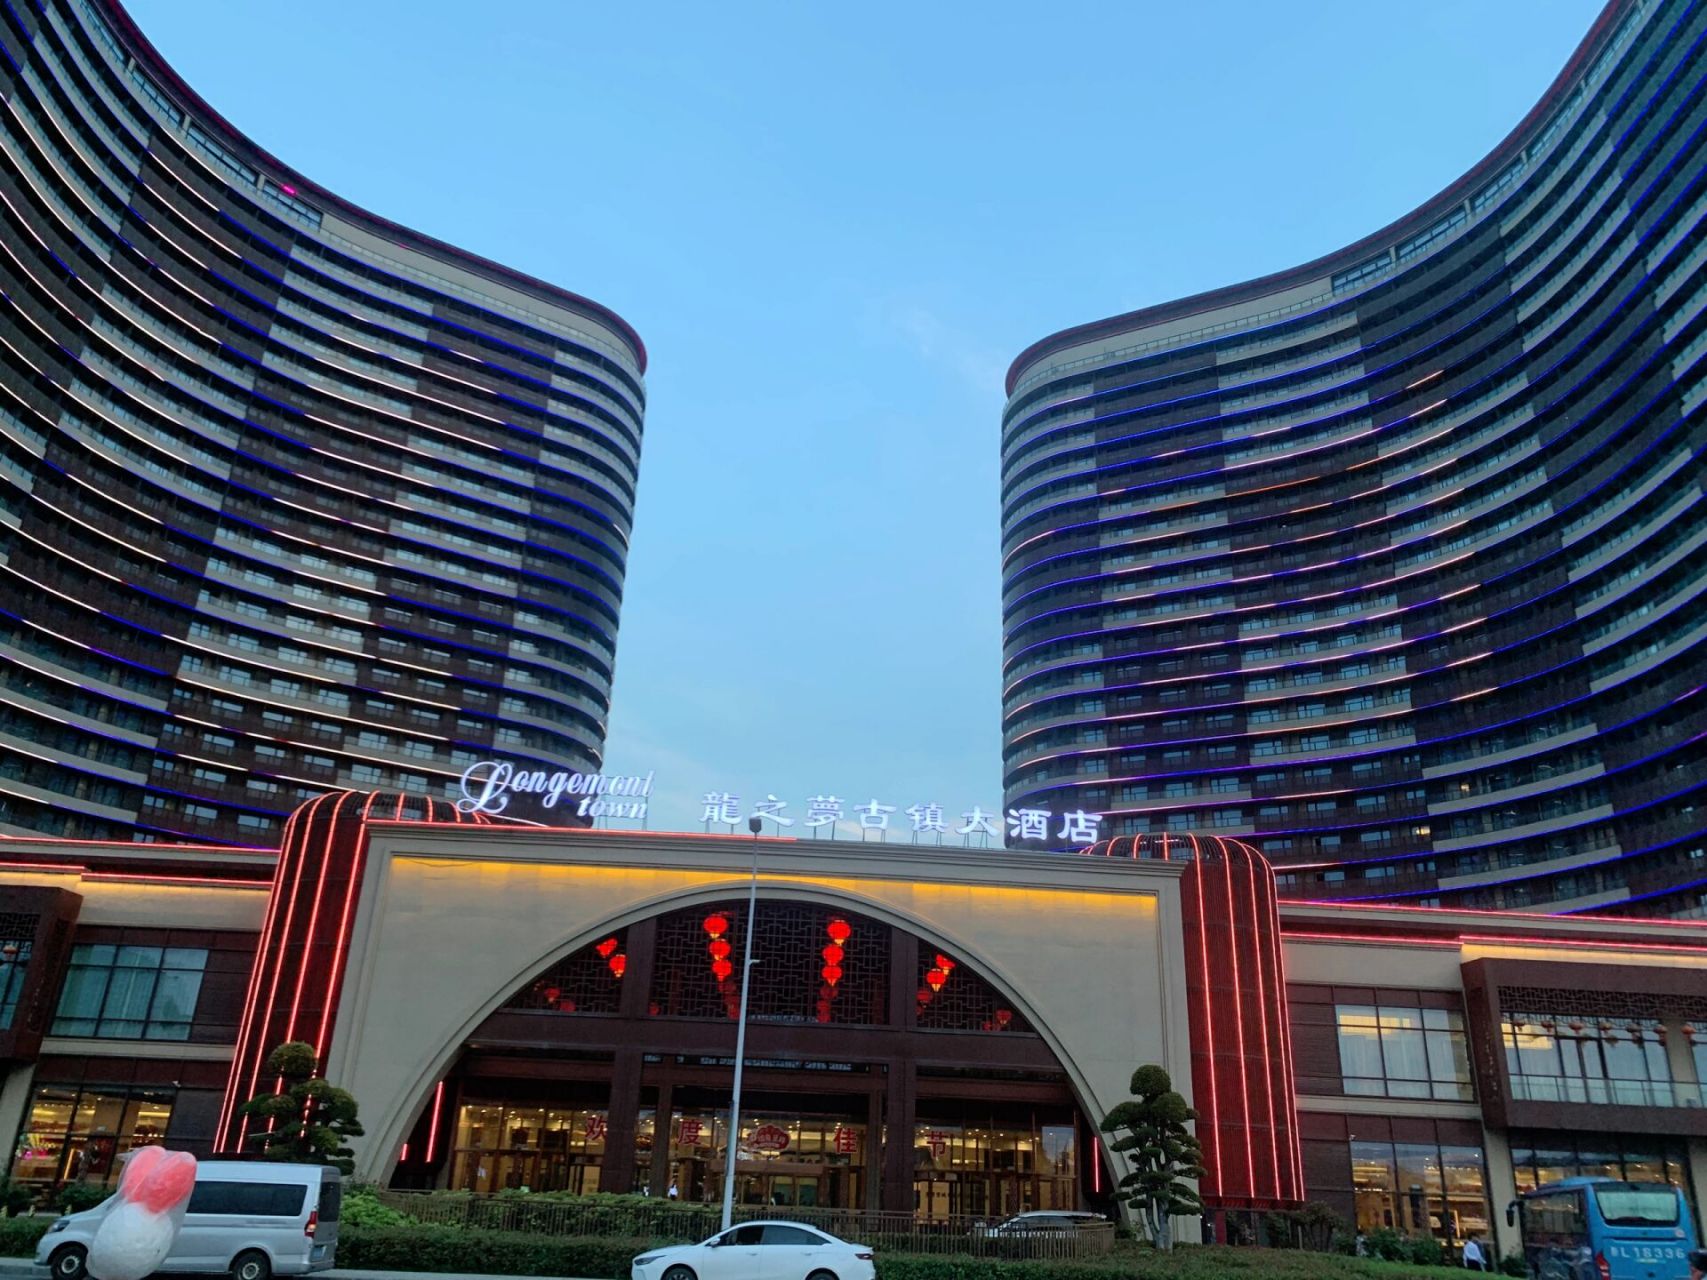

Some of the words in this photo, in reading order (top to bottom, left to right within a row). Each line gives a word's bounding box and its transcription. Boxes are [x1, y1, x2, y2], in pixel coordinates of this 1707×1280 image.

[457, 761, 655, 814] Longemont
[698, 791, 1103, 844] 龍之夢古镇大酒店
